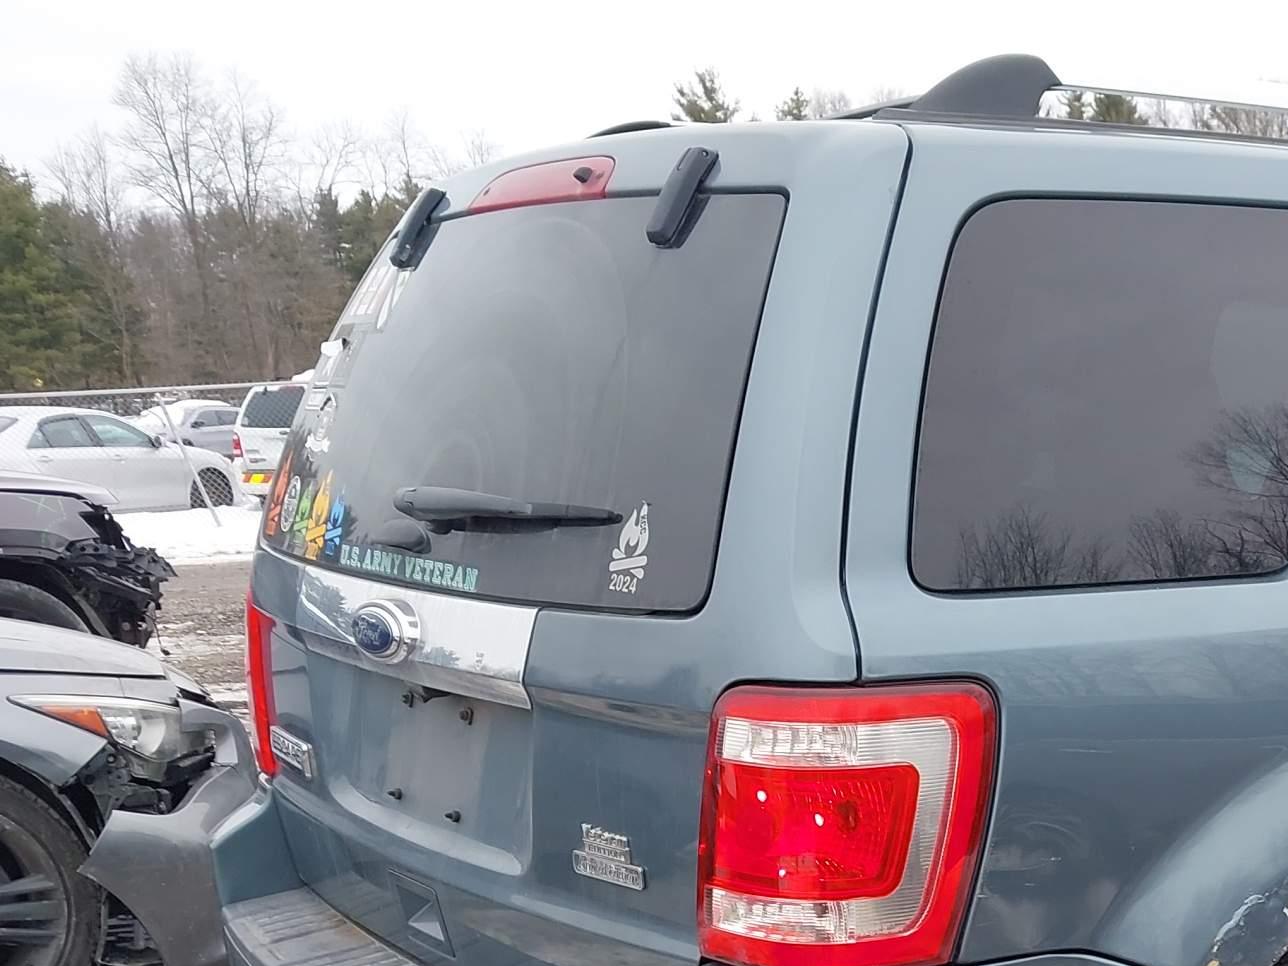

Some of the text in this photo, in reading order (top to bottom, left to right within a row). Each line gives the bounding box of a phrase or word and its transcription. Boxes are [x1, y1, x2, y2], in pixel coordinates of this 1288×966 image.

[339, 544, 361, 568] U.S.
[362, 549, 403, 575] ARMY
[405, 556, 479, 591] VETERAN
[608, 573, 638, 595] 2024
